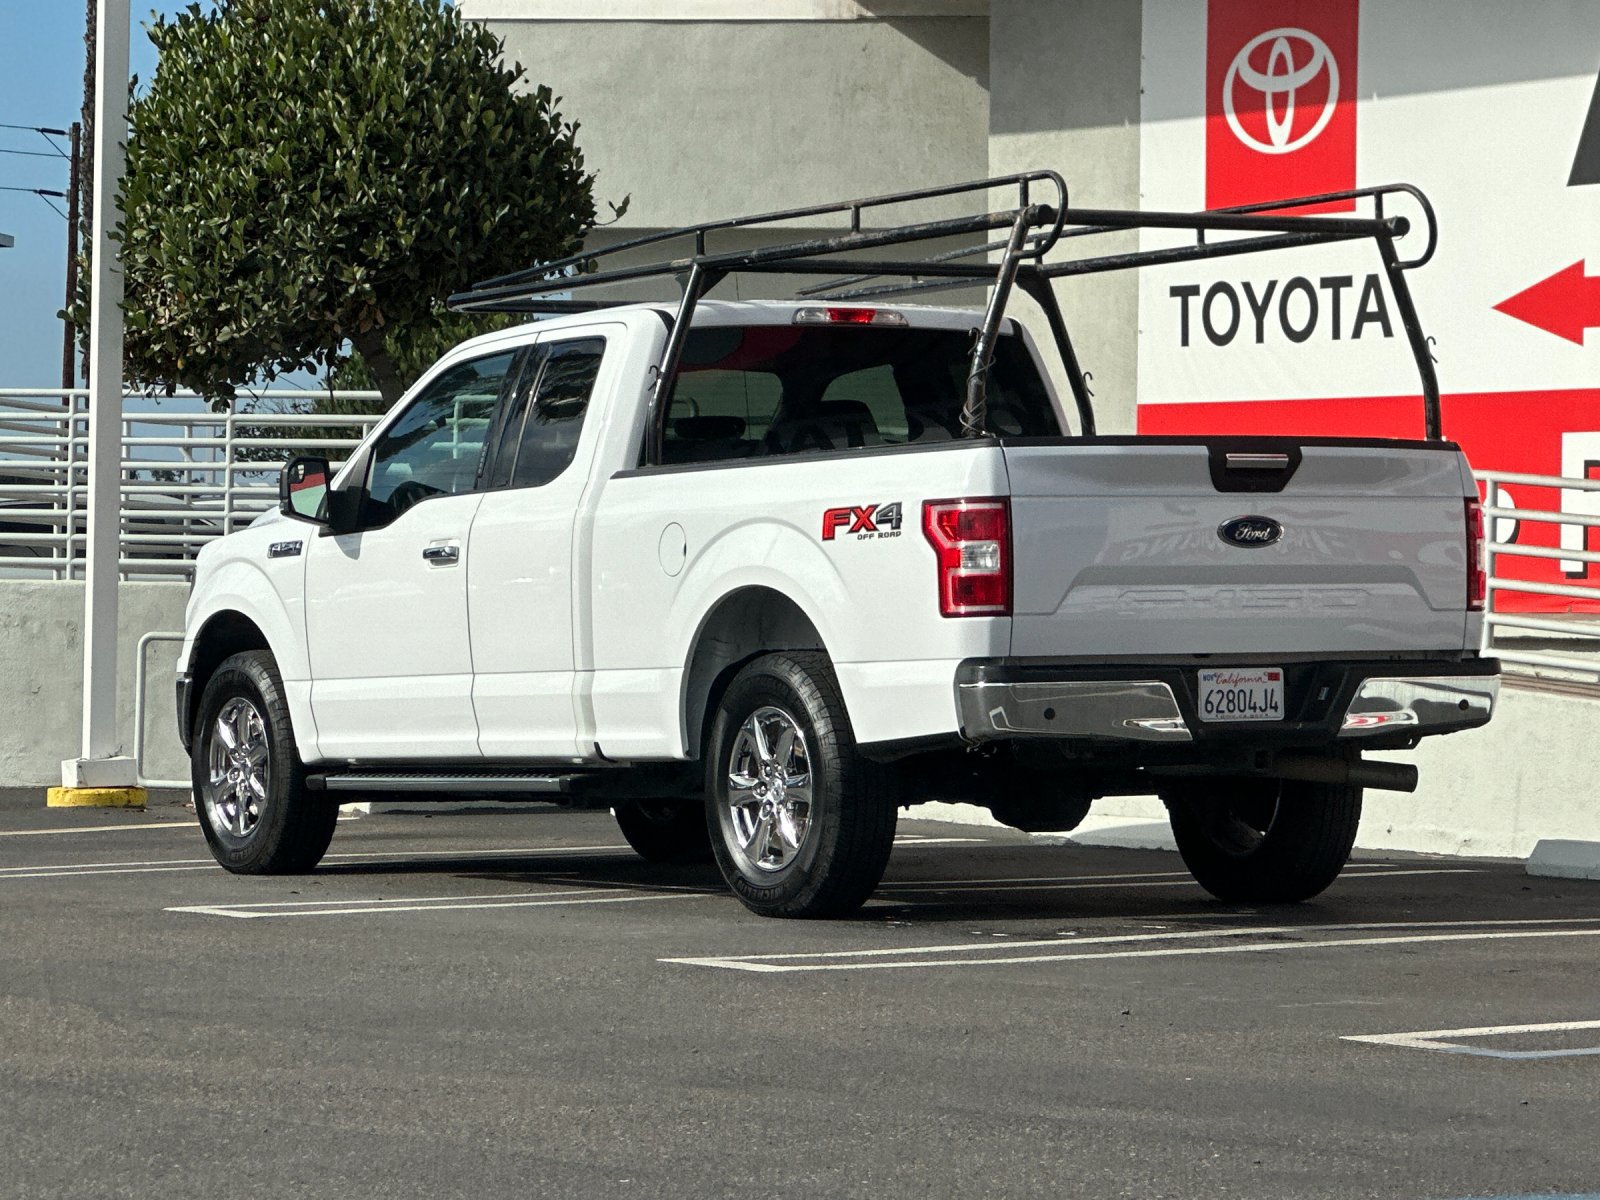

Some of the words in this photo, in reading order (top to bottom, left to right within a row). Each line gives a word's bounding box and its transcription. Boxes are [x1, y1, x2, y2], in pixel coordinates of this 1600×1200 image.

[1169, 273, 1394, 347] TOYOTA
[822, 501, 903, 541] FX4
[857, 533, 875, 541] OFF
[877, 530, 902, 539] ROAD
[1215, 672, 1264, 688] California
[1204, 688, 1279, 714] 62804J4
